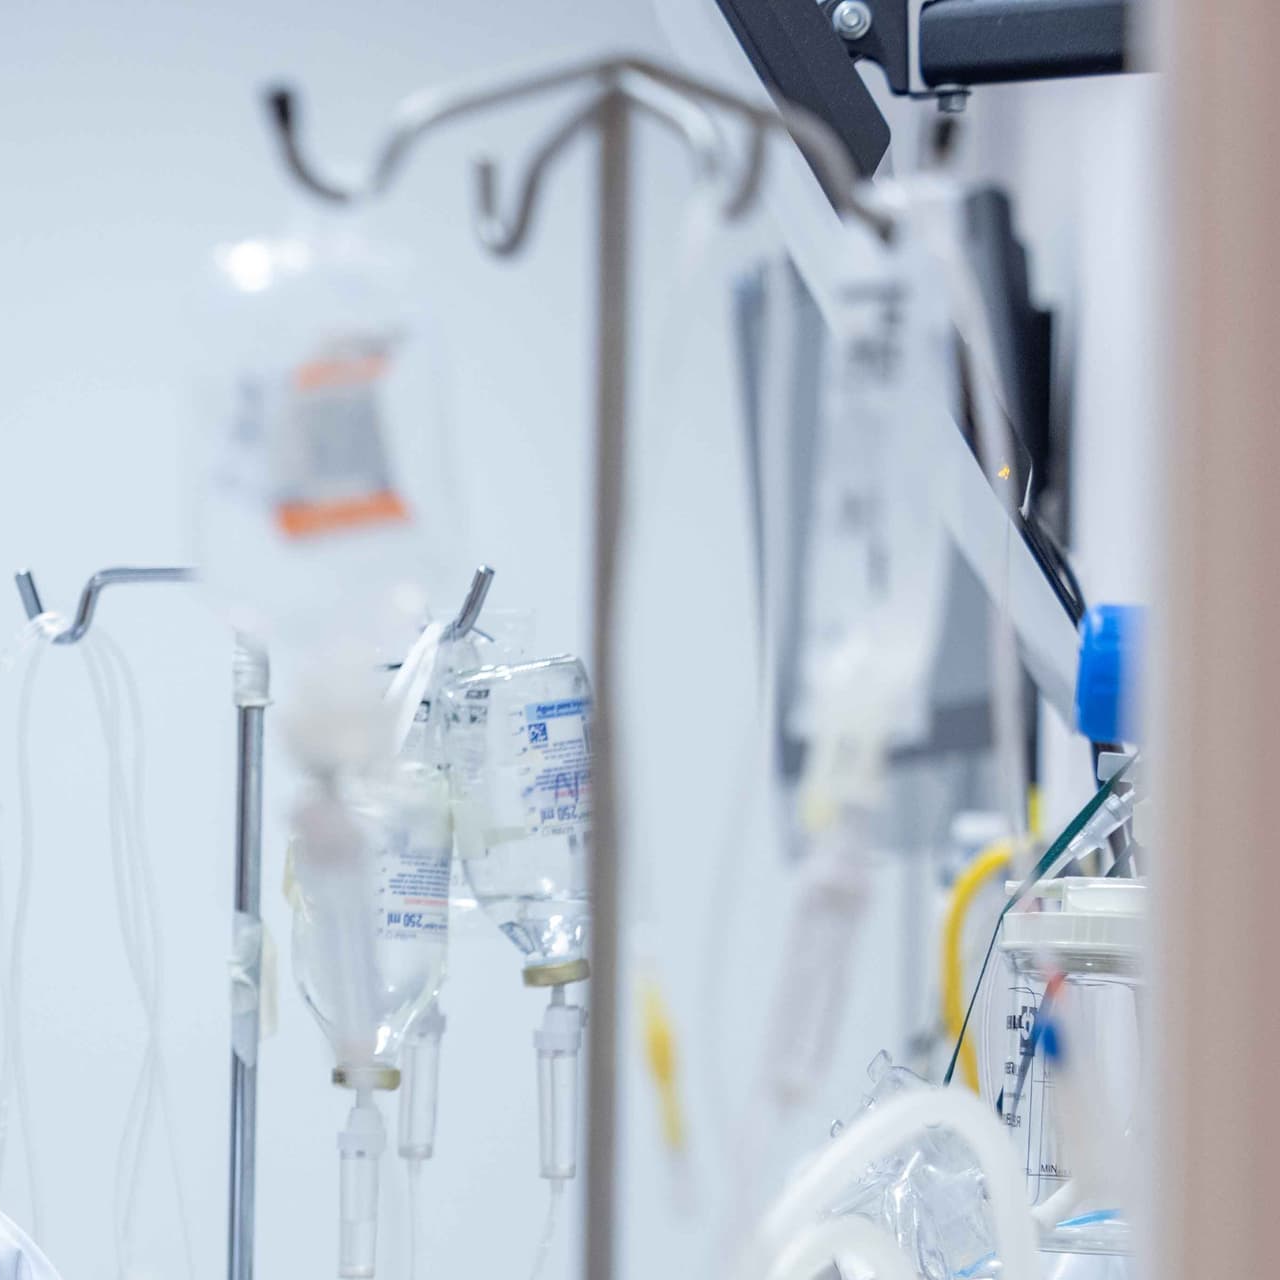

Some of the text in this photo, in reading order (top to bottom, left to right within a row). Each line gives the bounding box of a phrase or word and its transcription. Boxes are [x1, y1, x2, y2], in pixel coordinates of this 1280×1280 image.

[557, 805, 577, 821] 250
[387, 911, 401, 926] ml
[403, 912, 423, 928] 250
